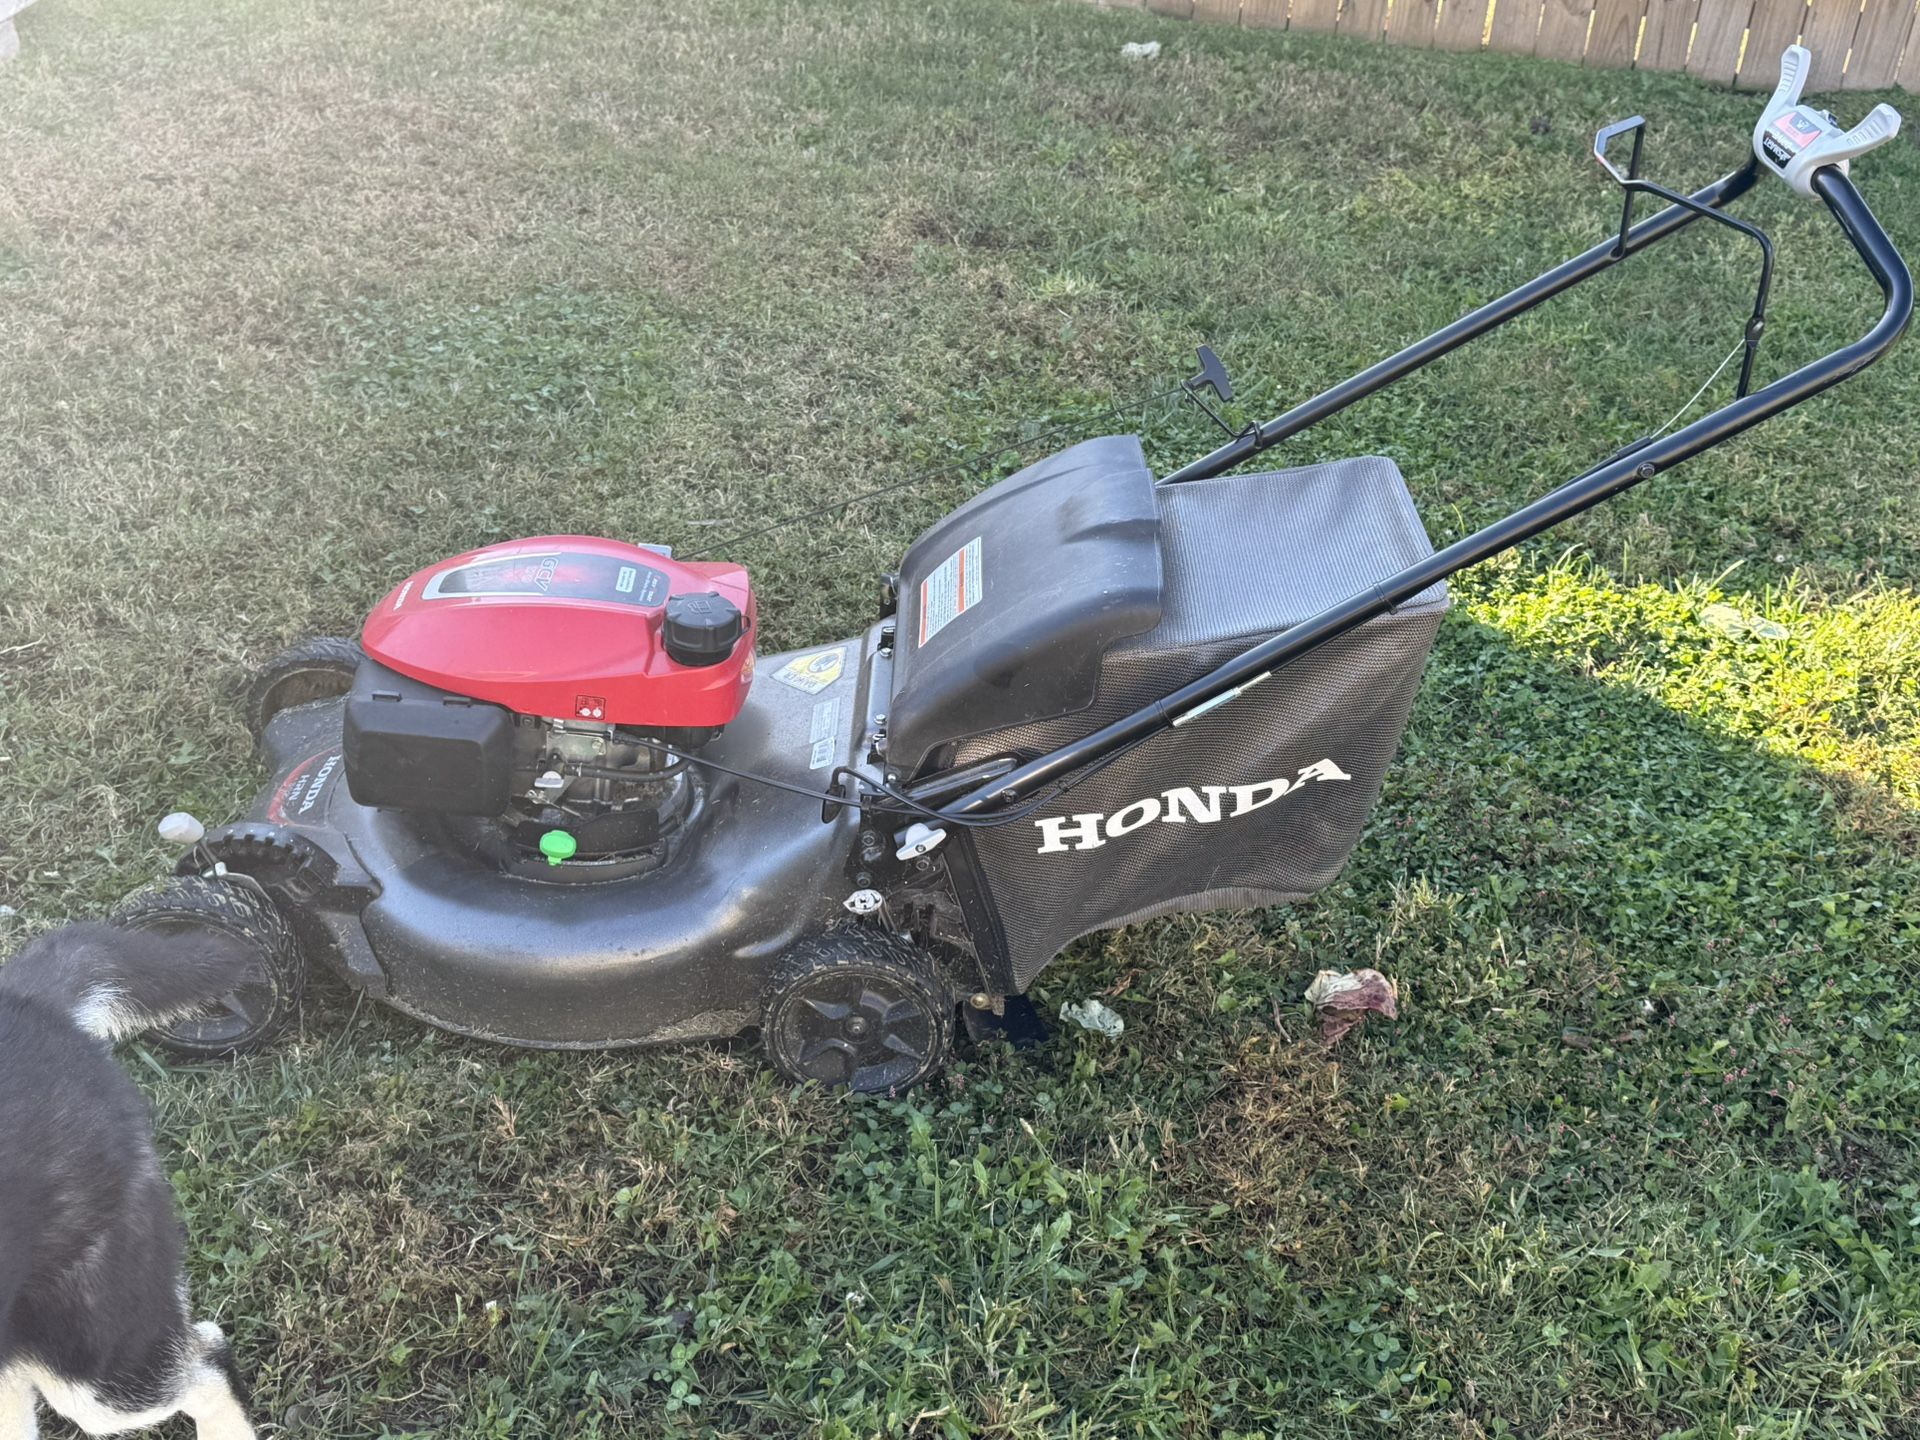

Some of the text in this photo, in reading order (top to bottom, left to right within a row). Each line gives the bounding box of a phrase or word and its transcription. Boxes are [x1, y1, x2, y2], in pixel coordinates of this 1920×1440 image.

[534, 557, 560, 591] GCV
[289, 775, 310, 800] HRN
[298, 754, 342, 814] HONDA
[1034, 758, 1351, 853] HONDA
